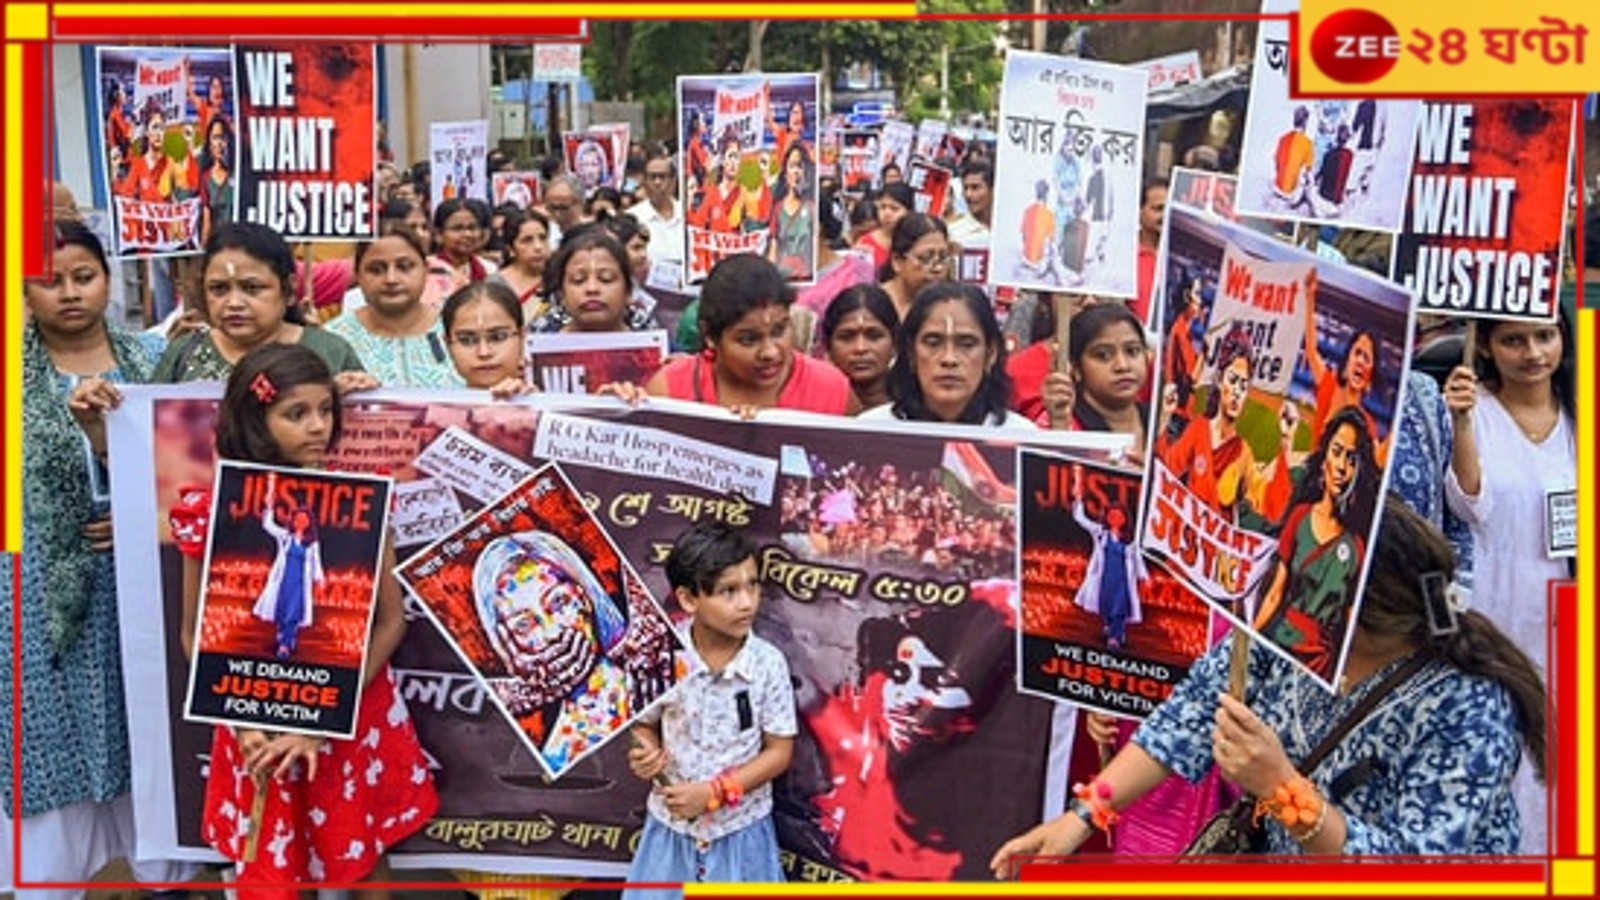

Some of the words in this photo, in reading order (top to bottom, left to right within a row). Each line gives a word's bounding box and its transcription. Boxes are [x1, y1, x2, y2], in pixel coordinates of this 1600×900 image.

[245, 51, 294, 107] WE
[249, 117, 334, 172] WANT
[1005, 115, 1056, 154] আর
[1062, 109, 1097, 158] জি
[1100, 128, 1139, 164] কর
[1417, 102, 1473, 164] WE
[247, 180, 371, 234] JUSTICE
[1413, 175, 1516, 239] WANT
[1225, 259, 1252, 302] We
[1253, 280, 1300, 316] want
[1405, 245, 1552, 316] JUSTICE
[541, 365, 587, 394] WE
[547, 440, 631, 469] headache
[632, 454, 663, 472] for
[663, 461, 718, 489] health
[719, 478, 759, 499] dept
[585, 426, 617, 445] Kar
[622, 432, 672, 456] Hosp
[673, 445, 742, 475] emerges
[745, 464, 765, 479] as
[229, 475, 376, 531] JUSTICE
[761, 548, 861, 599] বিকেল
[873, 575, 967, 605] ৫:৩০
[227, 659, 253, 676] WE
[256, 663, 331, 685] DEMAND
[1054, 643, 1082, 661] WE
[1086, 651, 1170, 680] DEMAND
[211, 675, 340, 707] JUSTICE
[225, 697, 259, 715] FOR
[263, 702, 321, 722] VICTIM
[1057, 679, 1096, 700] FOR
[1099, 689, 1157, 713] VICTI
[424, 814, 556, 851] বালুরঘাট
[561, 822, 622, 850] থানা
